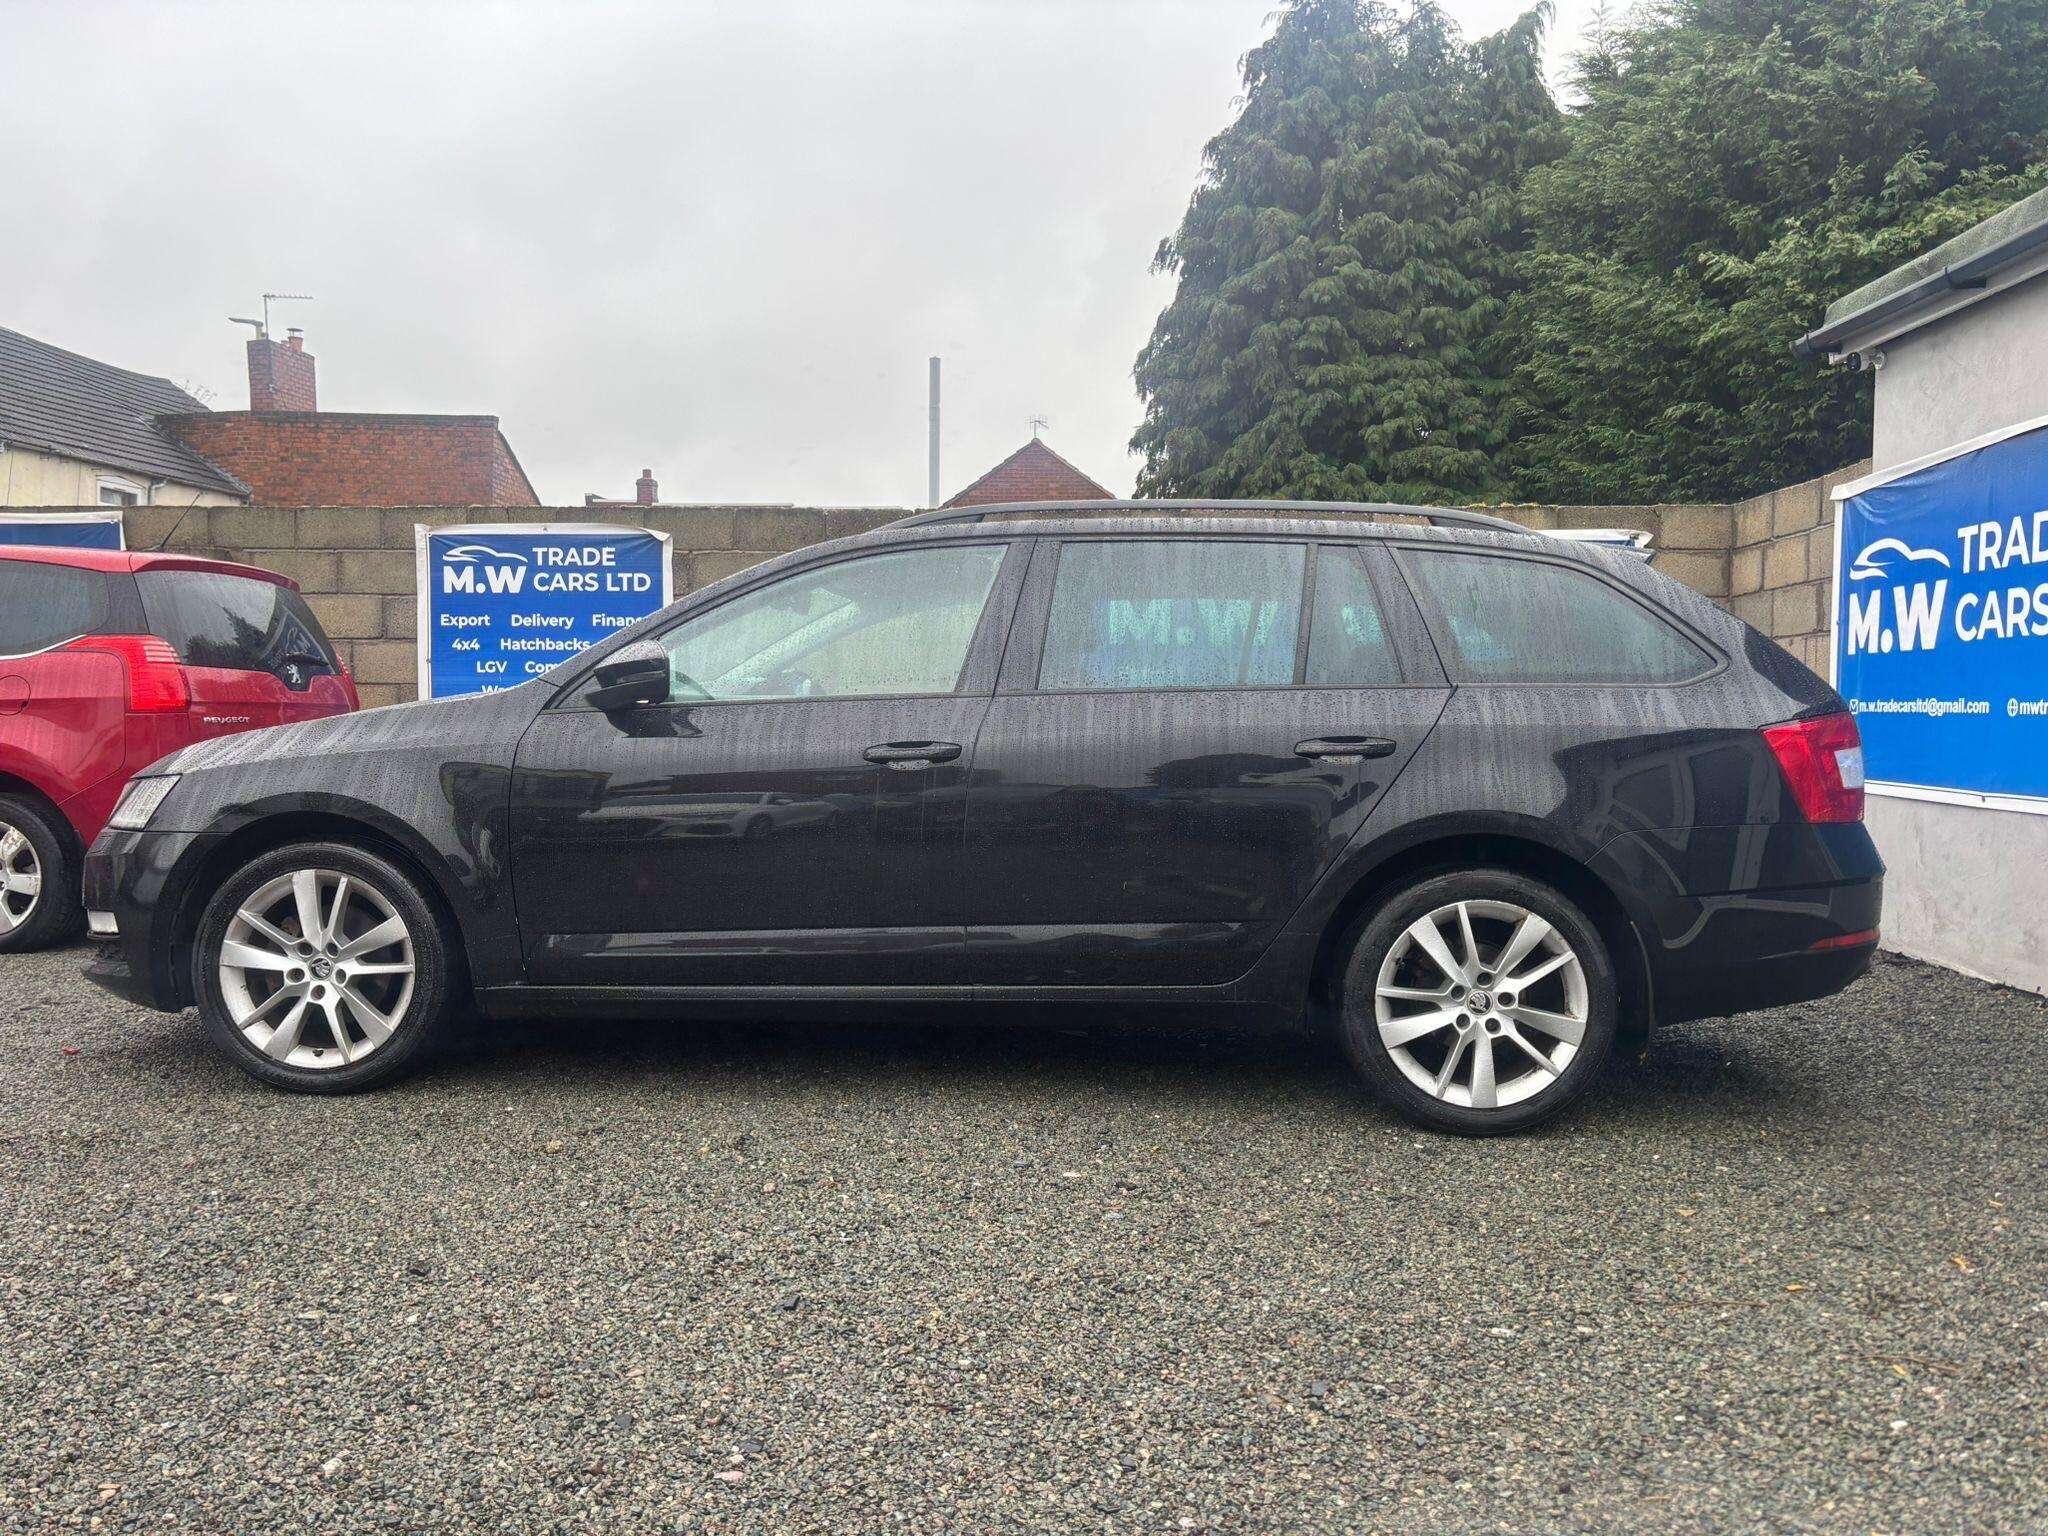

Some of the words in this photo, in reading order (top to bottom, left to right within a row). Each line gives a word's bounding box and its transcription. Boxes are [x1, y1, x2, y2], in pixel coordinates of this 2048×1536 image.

[1957, 510, 2048, 574] TRAD
[532, 547, 616, 567] TRADE
[443, 565, 527, 594] M.W
[533, 572, 600, 592] CARS
[606, 573, 652, 592] LTD
[440, 613, 491, 629] Export
[511, 613, 574, 630] Delivery
[1848, 579, 1948, 656] M.W
[1955, 582, 2048, 641] CARS
[451, 638, 480, 651] 4x4
[500, 637, 591, 651] Hatchbacks
[476, 661, 507, 673] LGV
[1859, 698, 1989, 716] m.w.tradecarsltd@gmail.com
[203, 716, 250, 724] PEUGEOT
